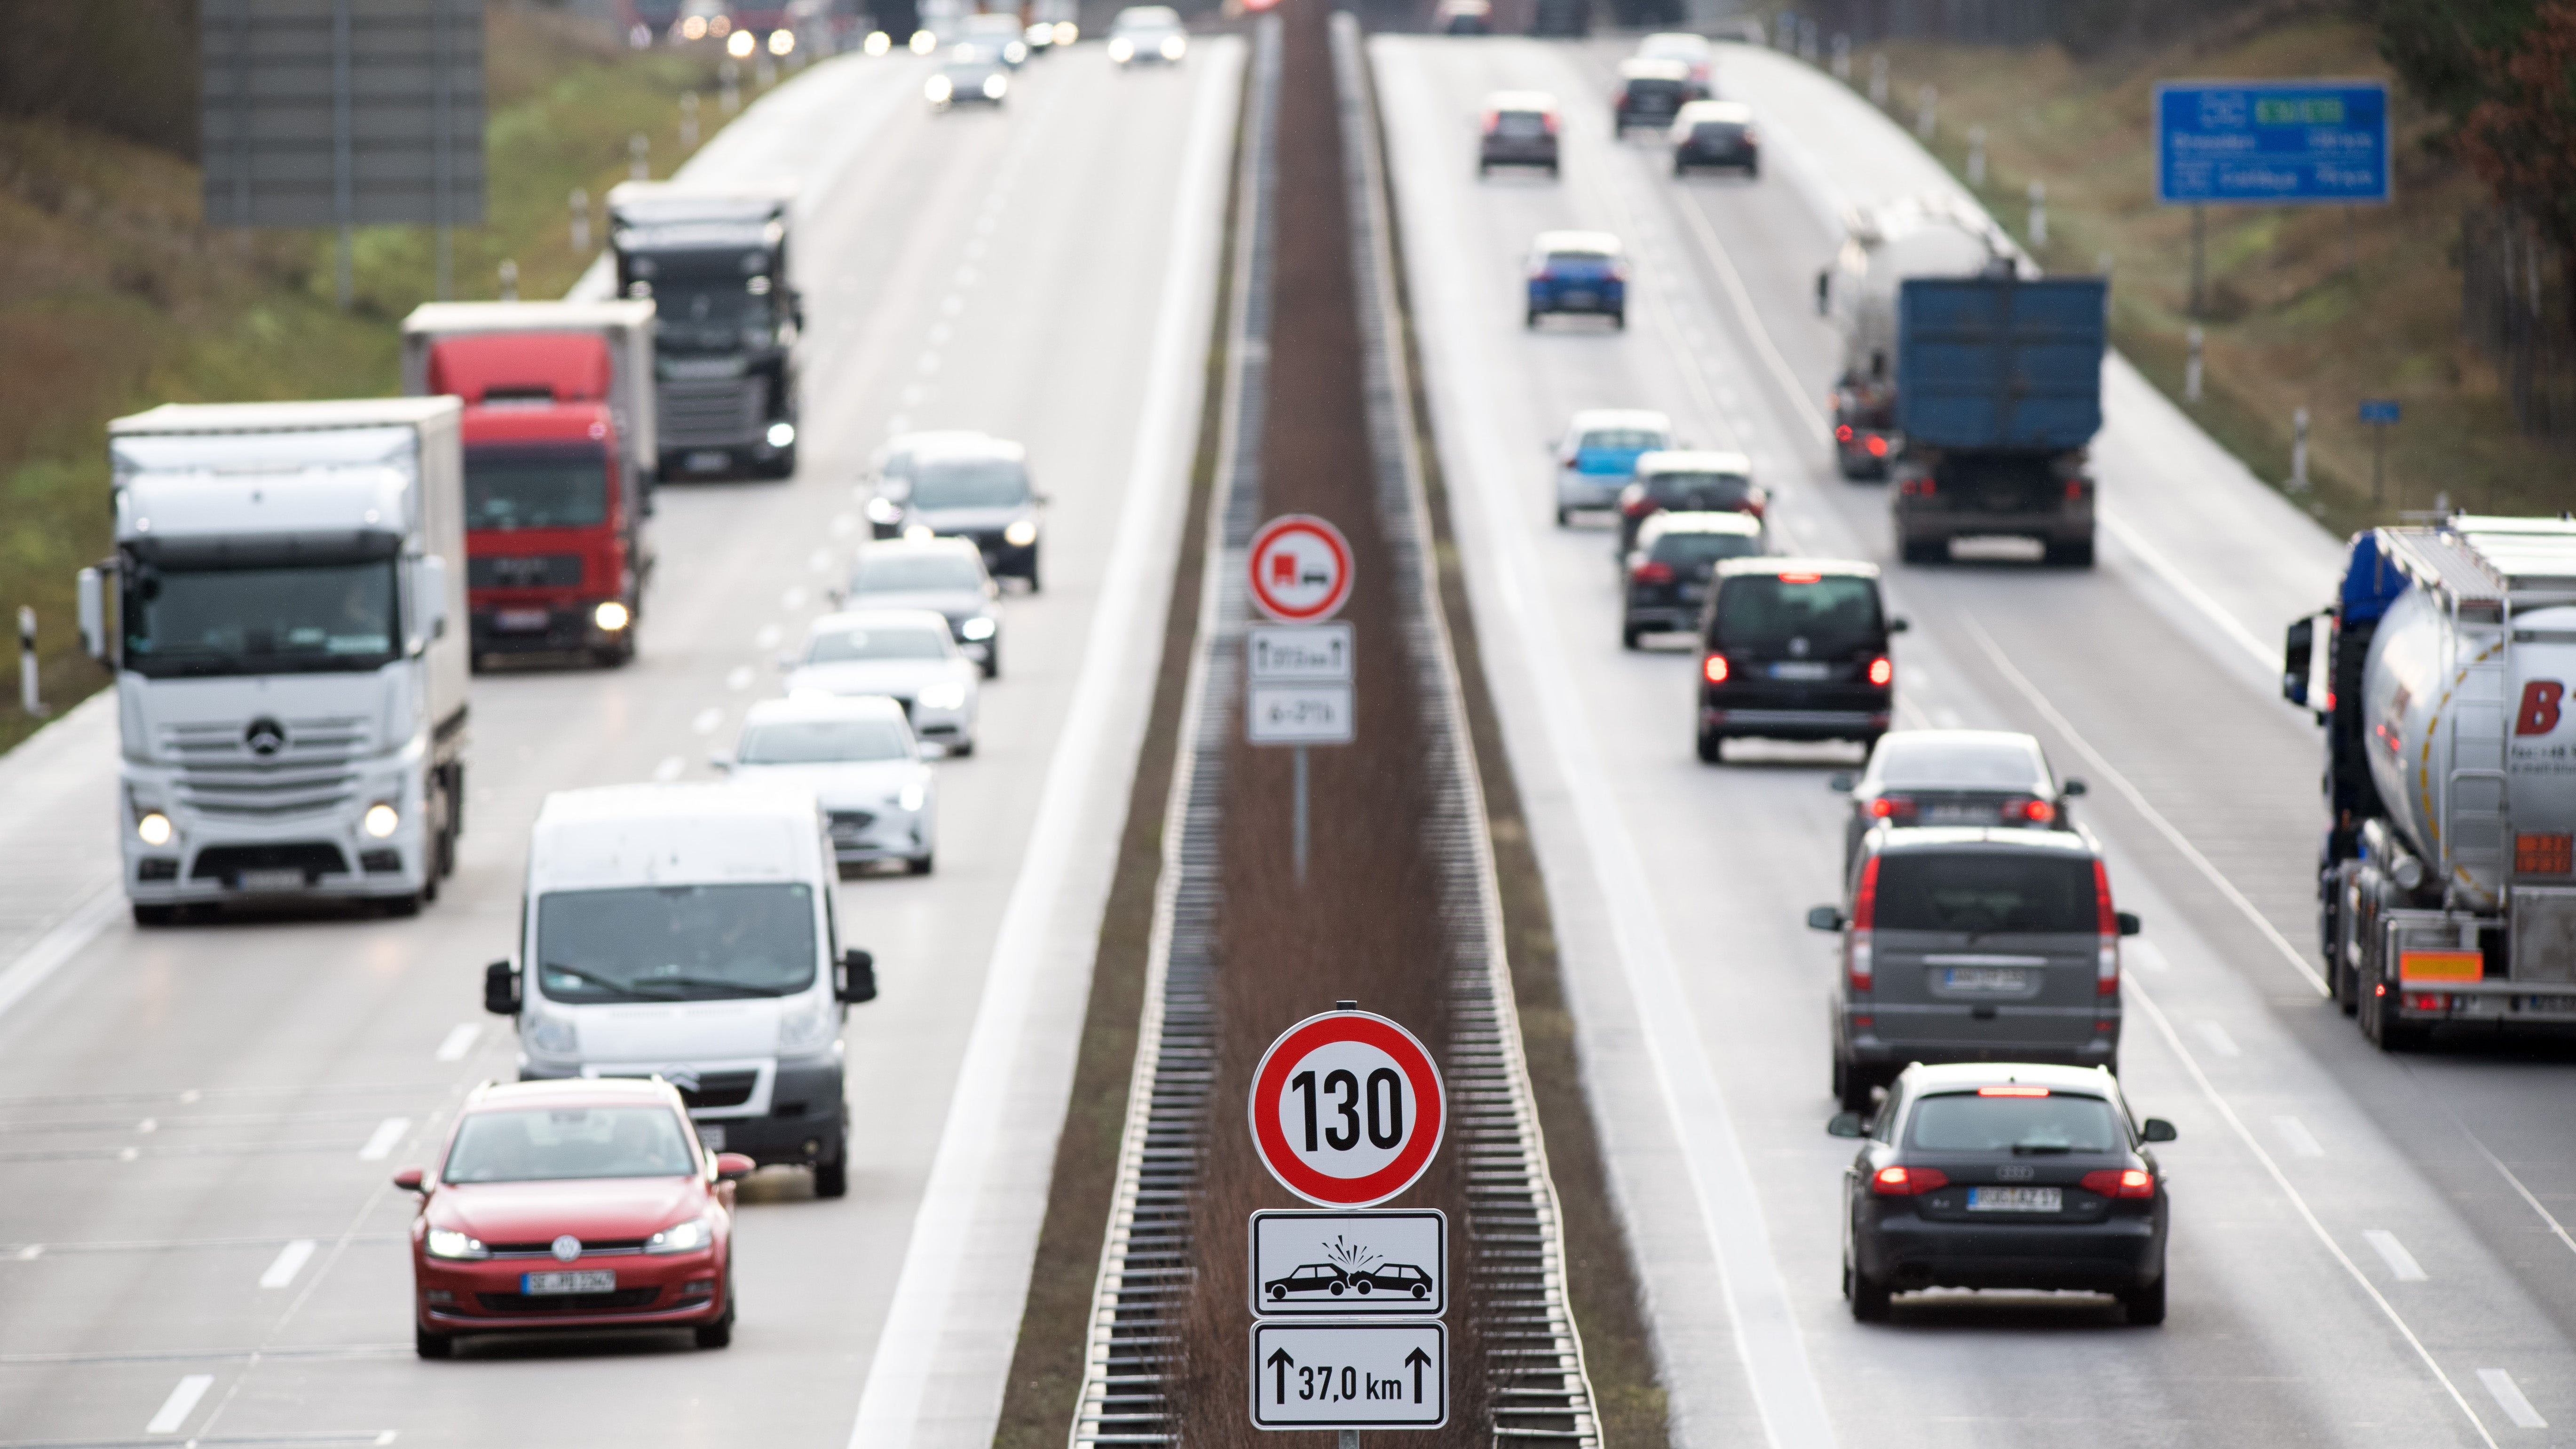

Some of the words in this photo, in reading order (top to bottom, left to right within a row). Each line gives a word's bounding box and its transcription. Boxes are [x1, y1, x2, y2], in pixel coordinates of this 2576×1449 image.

[1292, 1068, 1403, 1152] 130
[1298, 1366, 1357, 1403] 37,0
[1366, 1372, 1402, 1400] km
